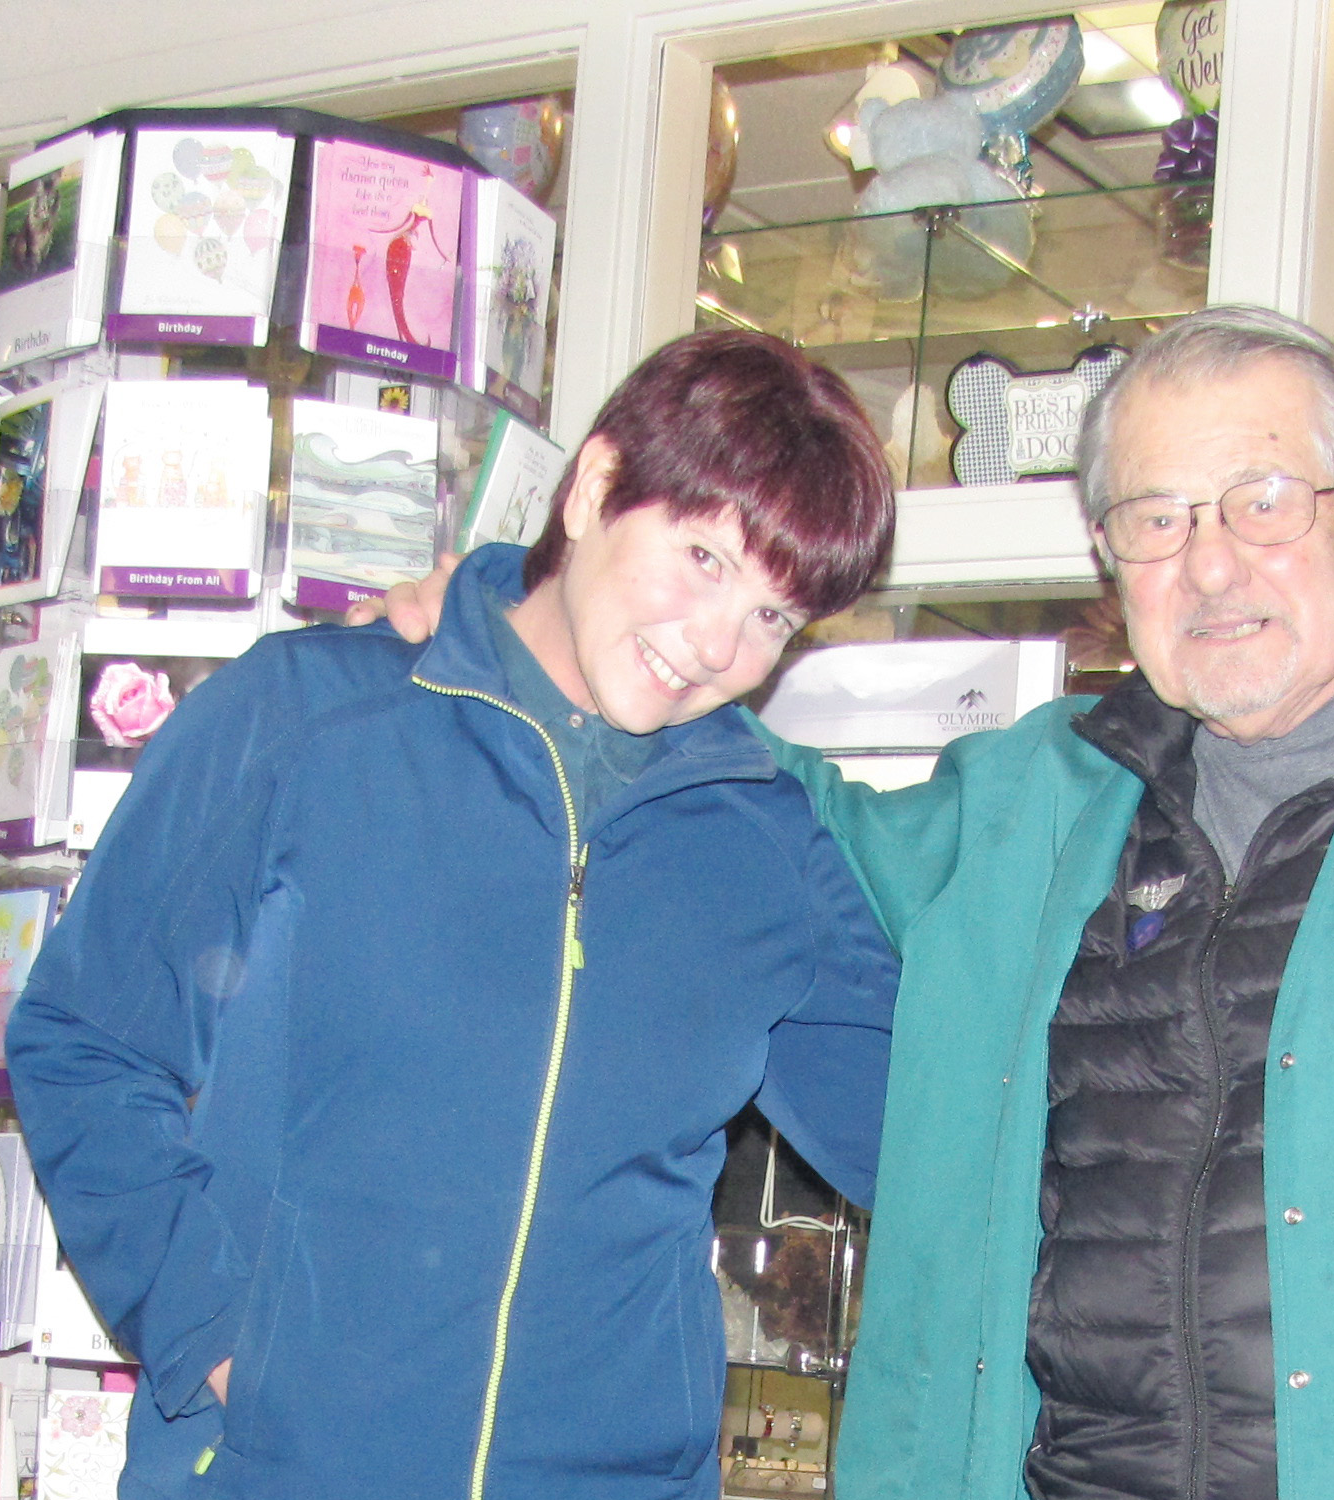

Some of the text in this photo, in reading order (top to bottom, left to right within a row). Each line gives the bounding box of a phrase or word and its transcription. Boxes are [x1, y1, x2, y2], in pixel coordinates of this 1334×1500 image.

[1181, 7, 1219, 57] Get
[158, 322, 203, 336] Birthday
[14, 331, 51, 354] Birthday
[366, 342, 409, 364] Birthday
[1013, 395, 1077, 417] BEST
[1015, 410, 1078, 432] FRIEND
[129, 573, 220, 587] Birthday From All
[937, 712, 1006, 726] OLYMPIC
